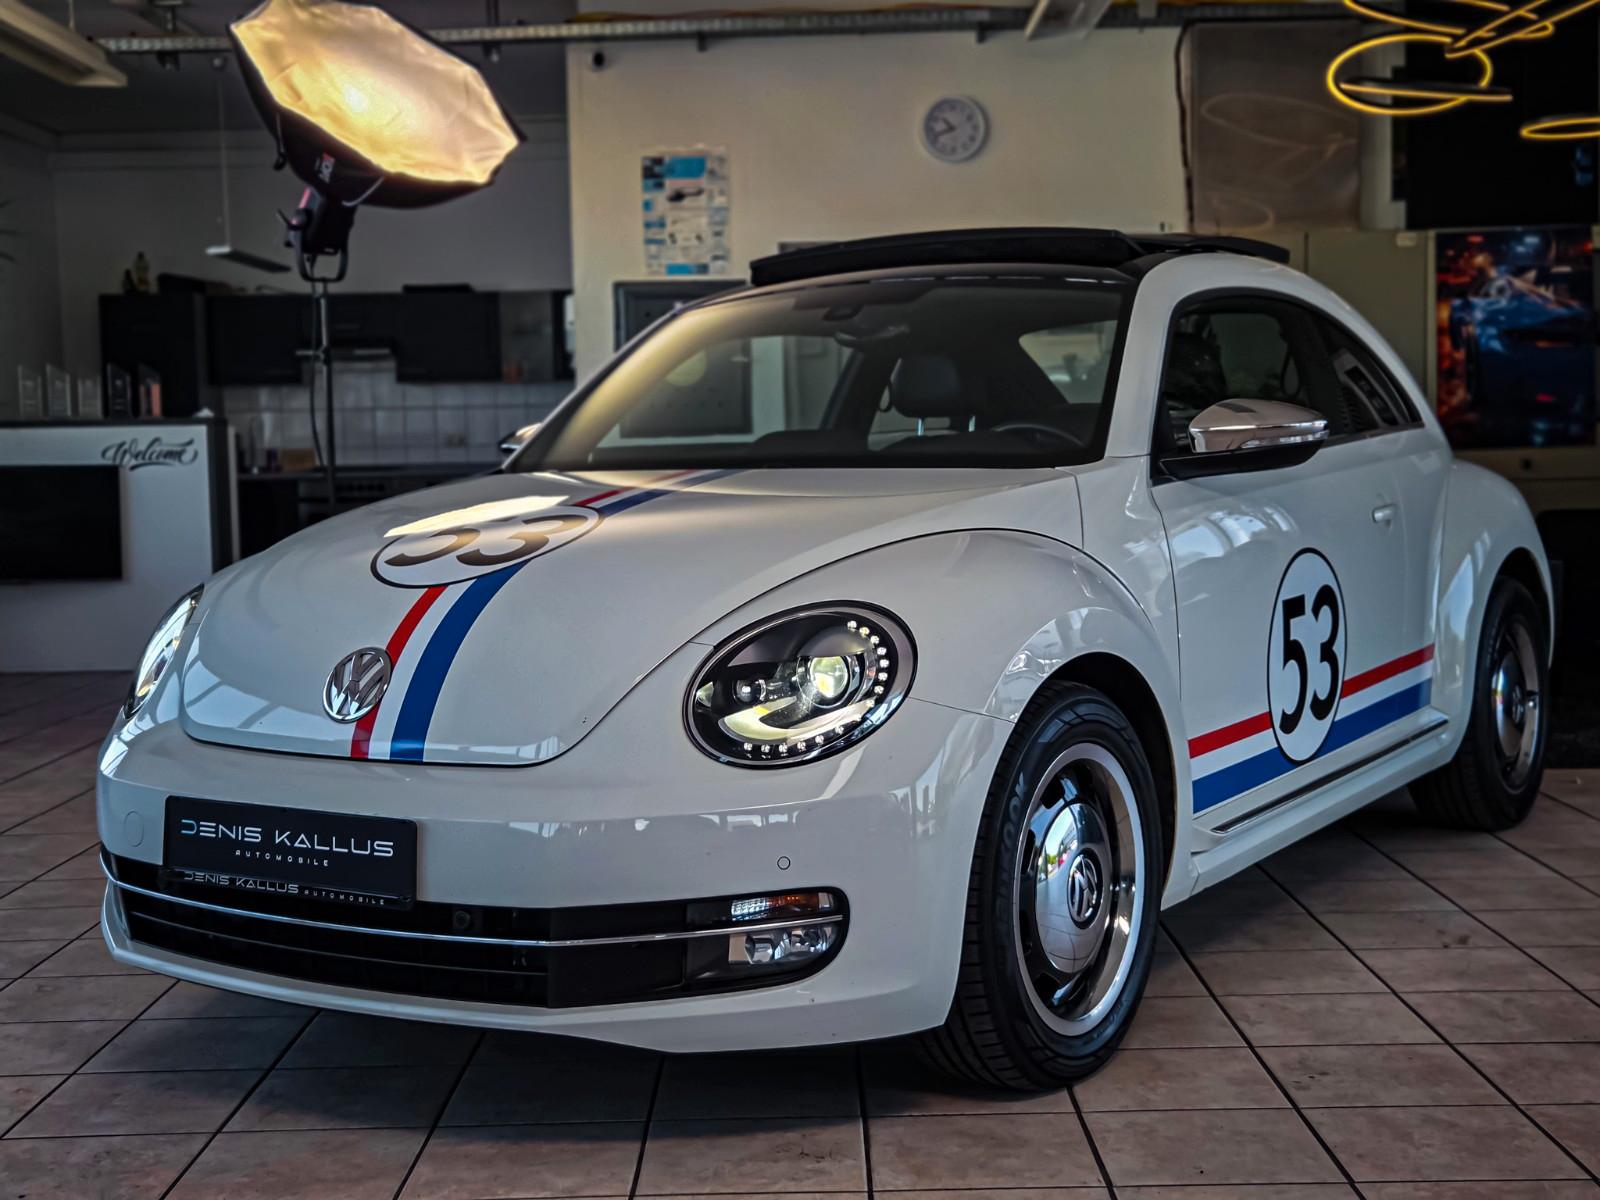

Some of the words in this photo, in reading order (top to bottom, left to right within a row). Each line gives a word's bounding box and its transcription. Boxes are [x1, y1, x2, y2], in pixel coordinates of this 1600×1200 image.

[101, 436, 198, 472] Welcome
[1279, 584, 1339, 735] 53
[181, 819, 262, 843] DENIS
[275, 829, 394, 857] KALLUS
[235, 850, 329, 867] AUTOMOBILE
[184, 870, 230, 885] DENIS
[236, 877, 299, 894] KALLUS
[304, 889, 384, 905] AUTOMOBILE
